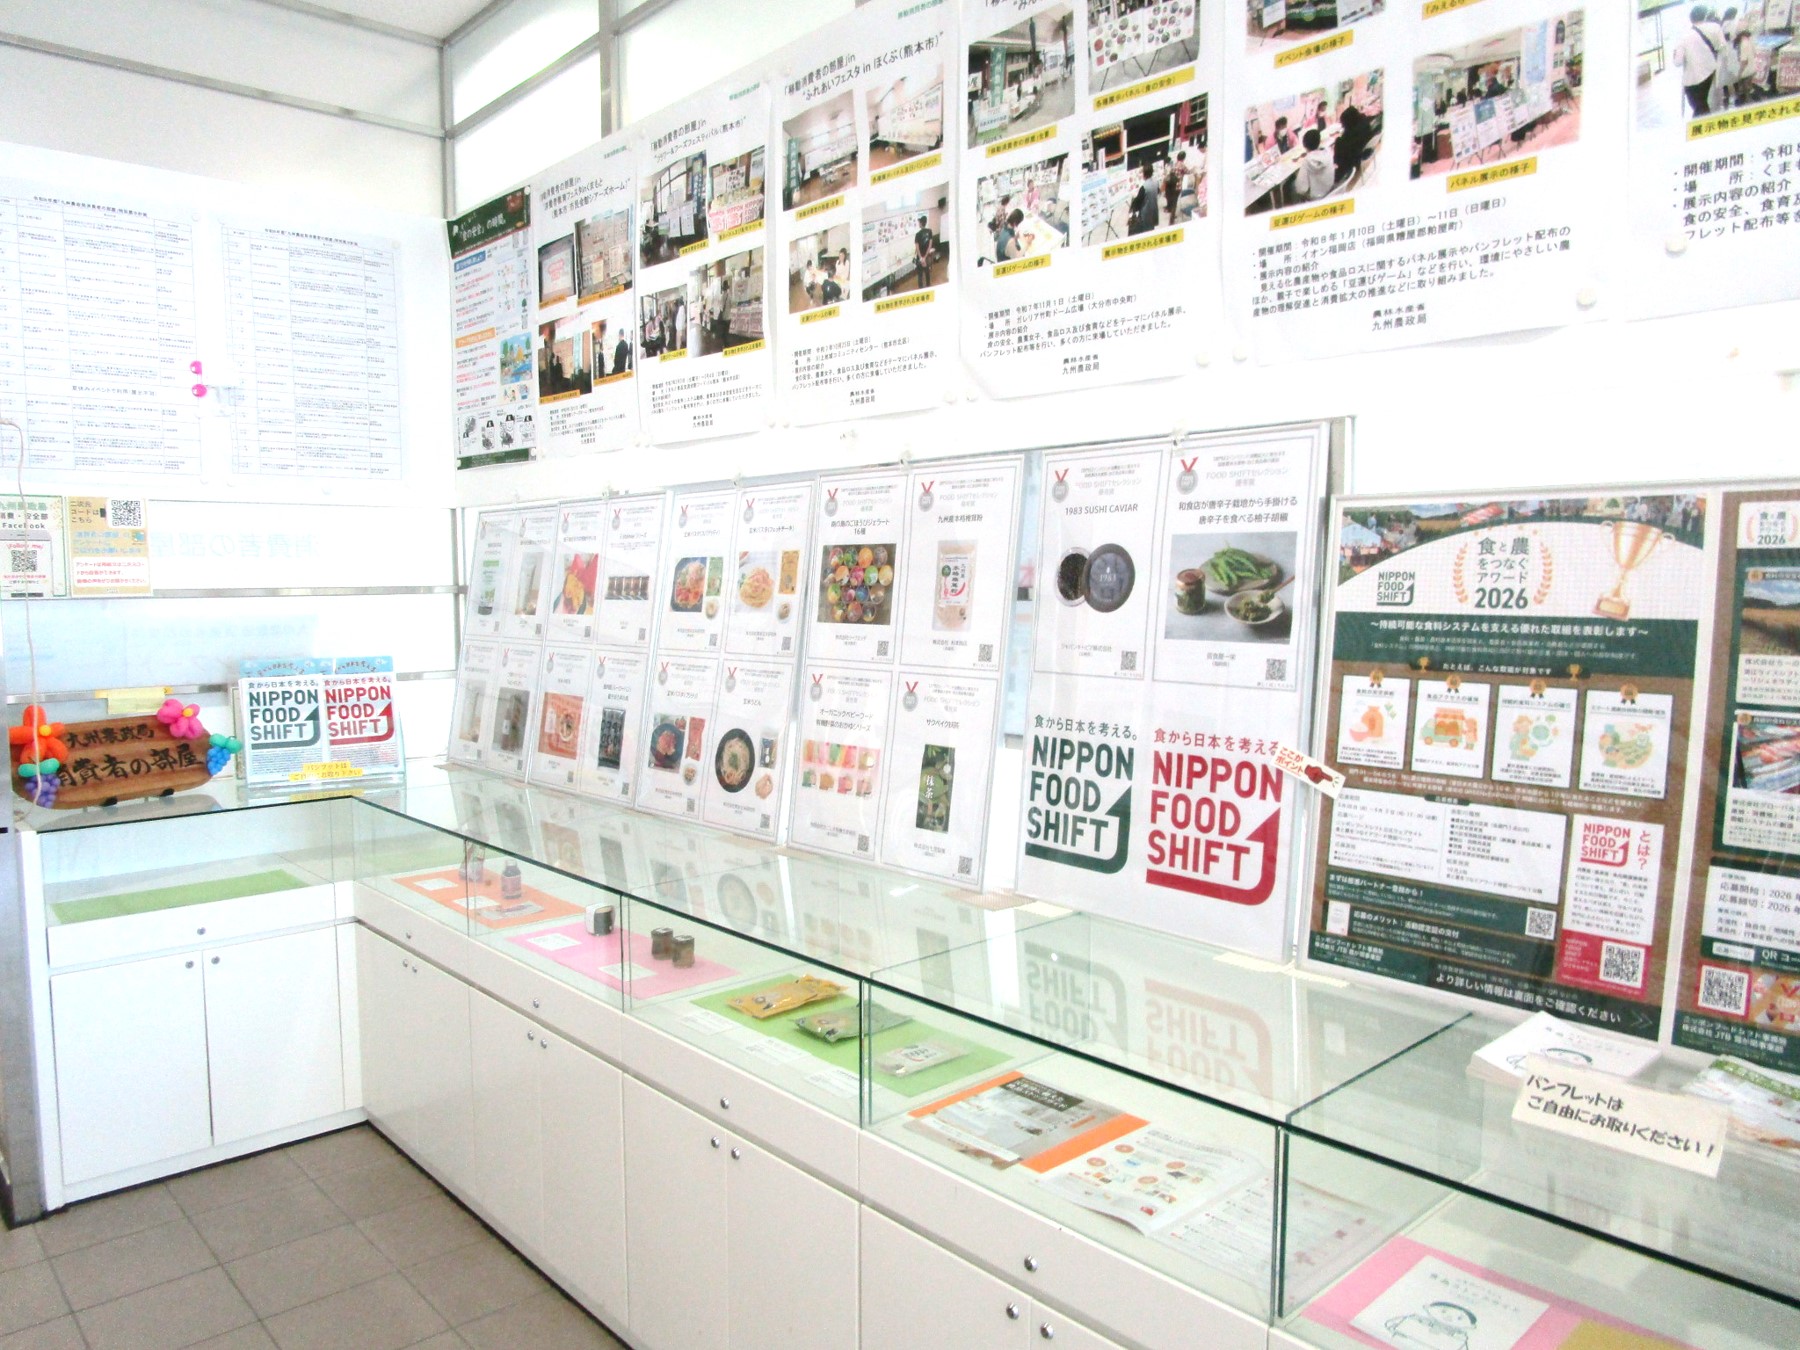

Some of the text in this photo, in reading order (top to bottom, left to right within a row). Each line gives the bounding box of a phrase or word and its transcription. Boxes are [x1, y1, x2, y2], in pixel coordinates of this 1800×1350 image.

[1451, 163, 1530, 189] パネル展示の様子
[1273, 204, 1346, 227] 豆選びゲームの様子
[1372, 314, 1427, 331] 九州農政局
[1062, 362, 1100, 375] 九州農政局
[1065, 503, 1138, 516] 1983 SUSHI CAVIAR
[1478, 537, 1529, 556] 食と農
[1757, 535, 1786, 545] 2026
[1478, 558, 1528, 570] をつなぐ
[1378, 571, 1415, 581] NIPPON
[1477, 572, 1528, 584] アワード
[1377, 582, 1404, 591] FOOD
[1377, 592, 1406, 601] SHIFT
[1474, 587, 1529, 609] 2026
[249, 688, 319, 706] NIPPON
[325, 685, 392, 704] NIPPON
[251, 707, 300, 724] FOOD
[327, 703, 375, 720] FOOD
[251, 722, 307, 741] SHIFT
[328, 719, 381, 737] SHIFT
[1034, 714, 1137, 741] 食から日本を考える。
[1032, 735, 1134, 781] NIPPON
[1280, 746, 1304, 762] ここが
[1276, 756, 1304, 774] ポイント
[1152, 750, 1284, 803] NIPPON
[1030, 771, 1101, 813] FOOD
[1151, 790, 1241, 837] FOOD
[1027, 806, 1109, 853] SHIFT
[1584, 823, 1631, 838] NIPPON
[1582, 834, 1616, 848] FOOD
[1147, 830, 1251, 881] SHIFT
[1581, 846, 1619, 860] SHIFT
[1436, 971, 1621, 1023] より詳しい情報は裏面をご確認ください
[1526, 1073, 1624, 1111] パンフレットは
[1528, 1095, 1715, 1157] ご自由にお取りください！
